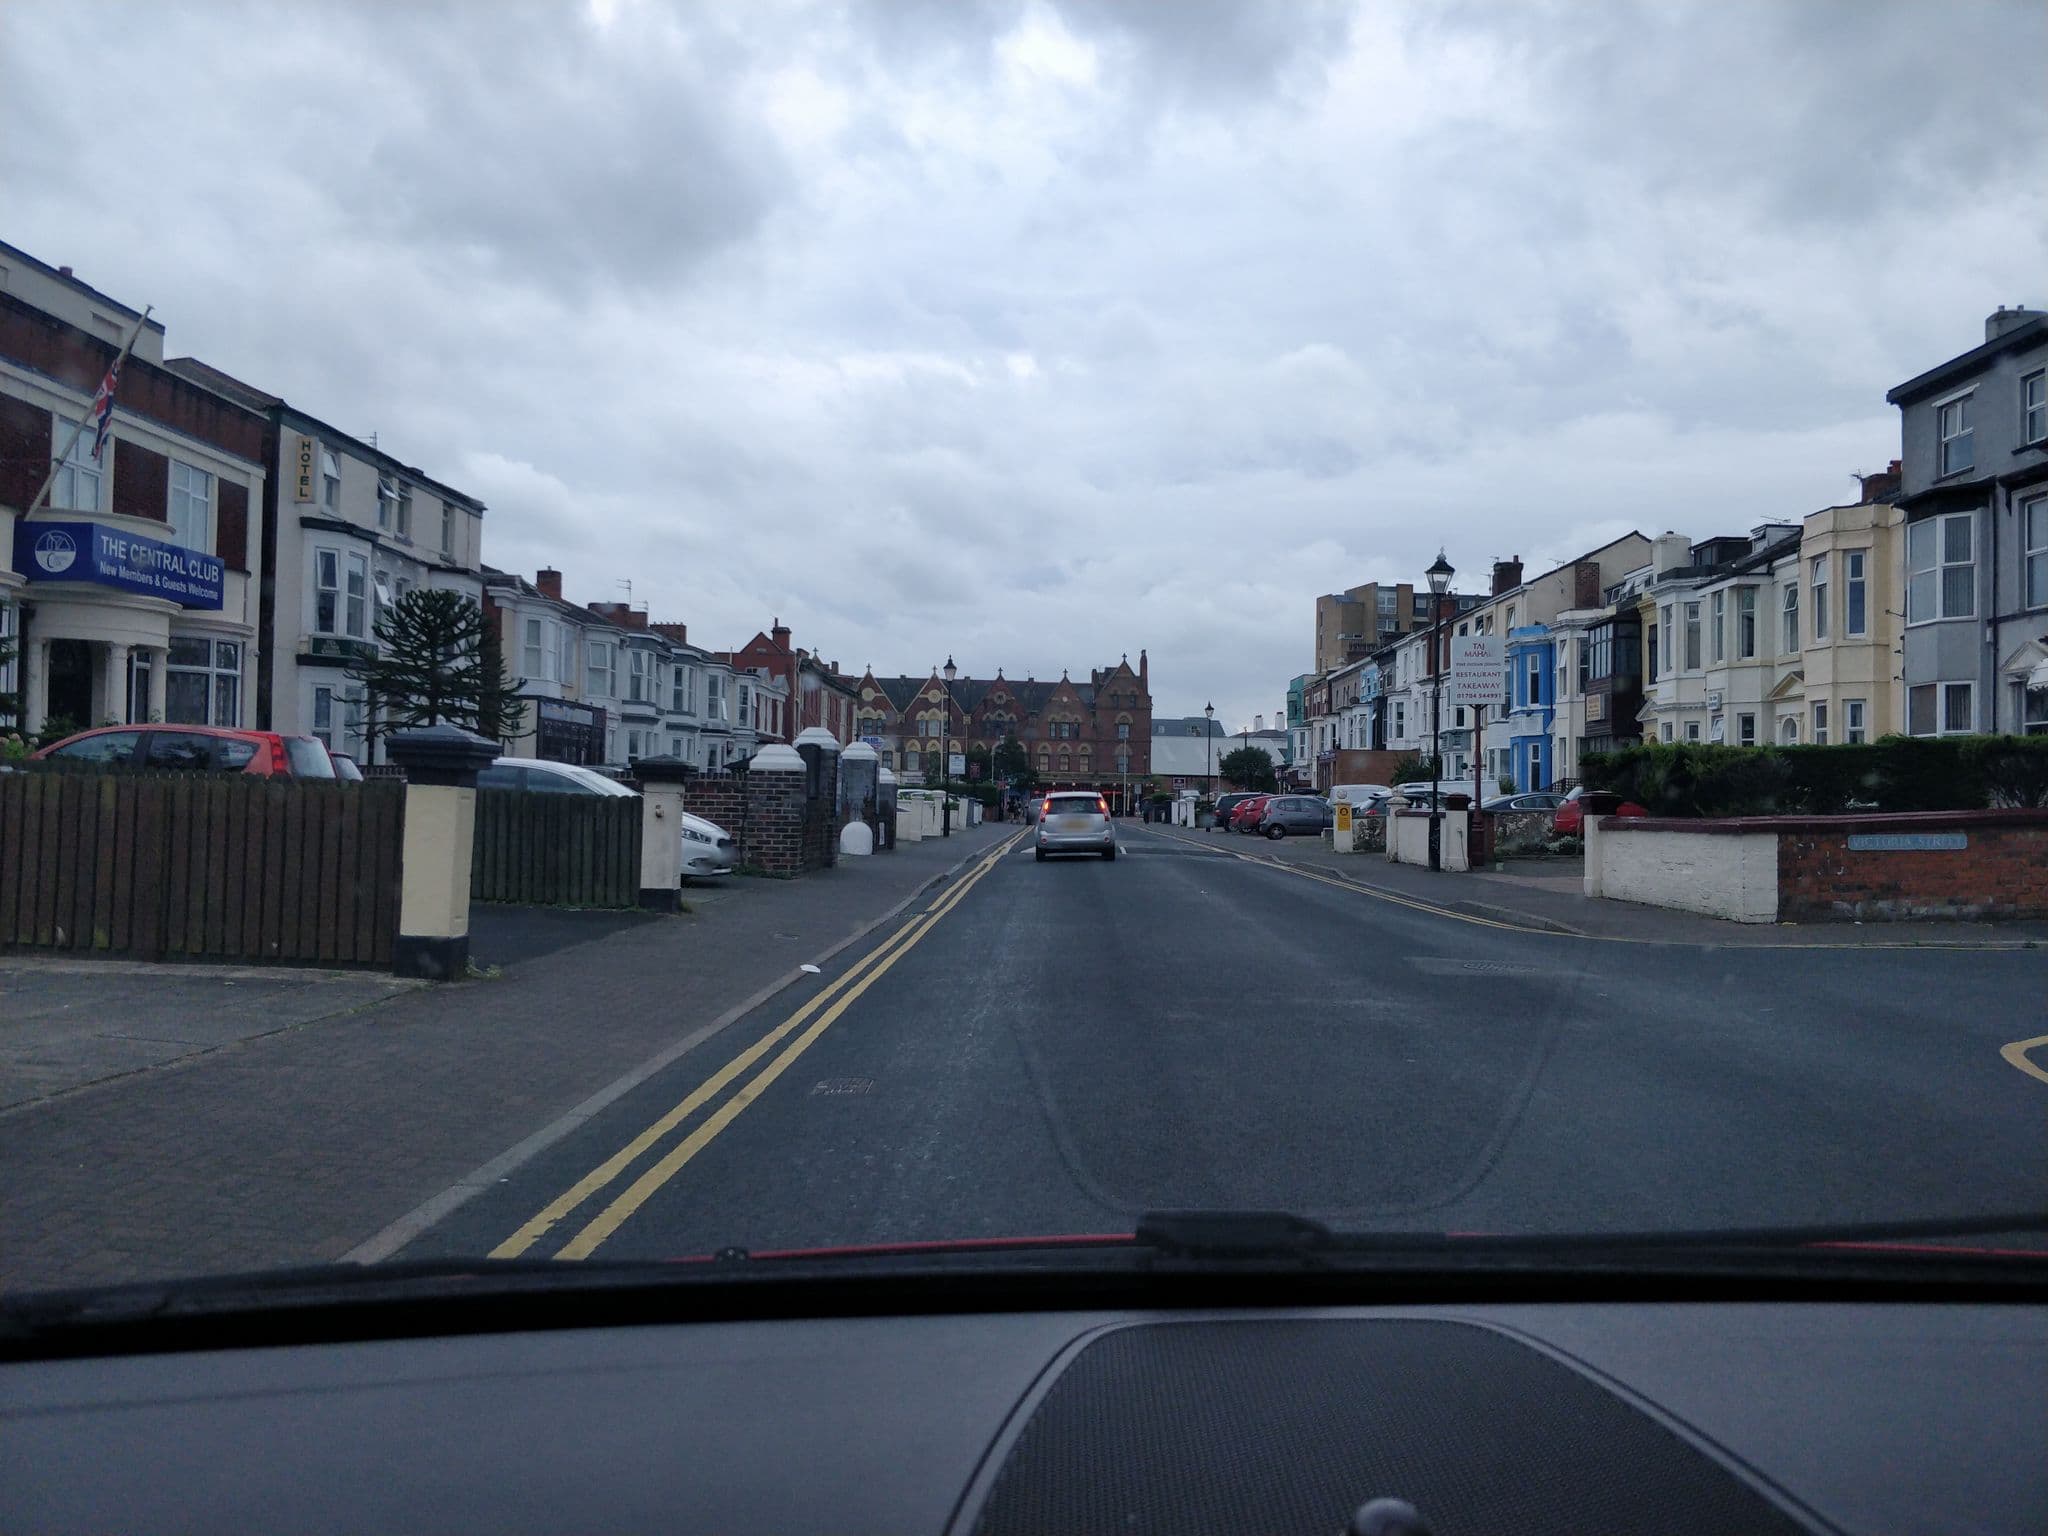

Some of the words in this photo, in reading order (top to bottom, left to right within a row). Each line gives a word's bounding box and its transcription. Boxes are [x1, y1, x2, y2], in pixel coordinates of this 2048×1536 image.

[299, 440, 311, 498] HOTEL
[101, 535, 127, 560] THE
[130, 543, 187, 575] CENTRAL
[189, 560, 219, 583] CLUB
[100, 561, 117, 577] New
[119, 565, 153, 586] Members
[155, 574, 161, 587] &
[162, 576, 187, 593] Guests
[188, 582, 219, 600] Welcome
[1472, 642, 1485, 651] TAJ
[1457, 682, 1501, 690] TAKEAWAY
